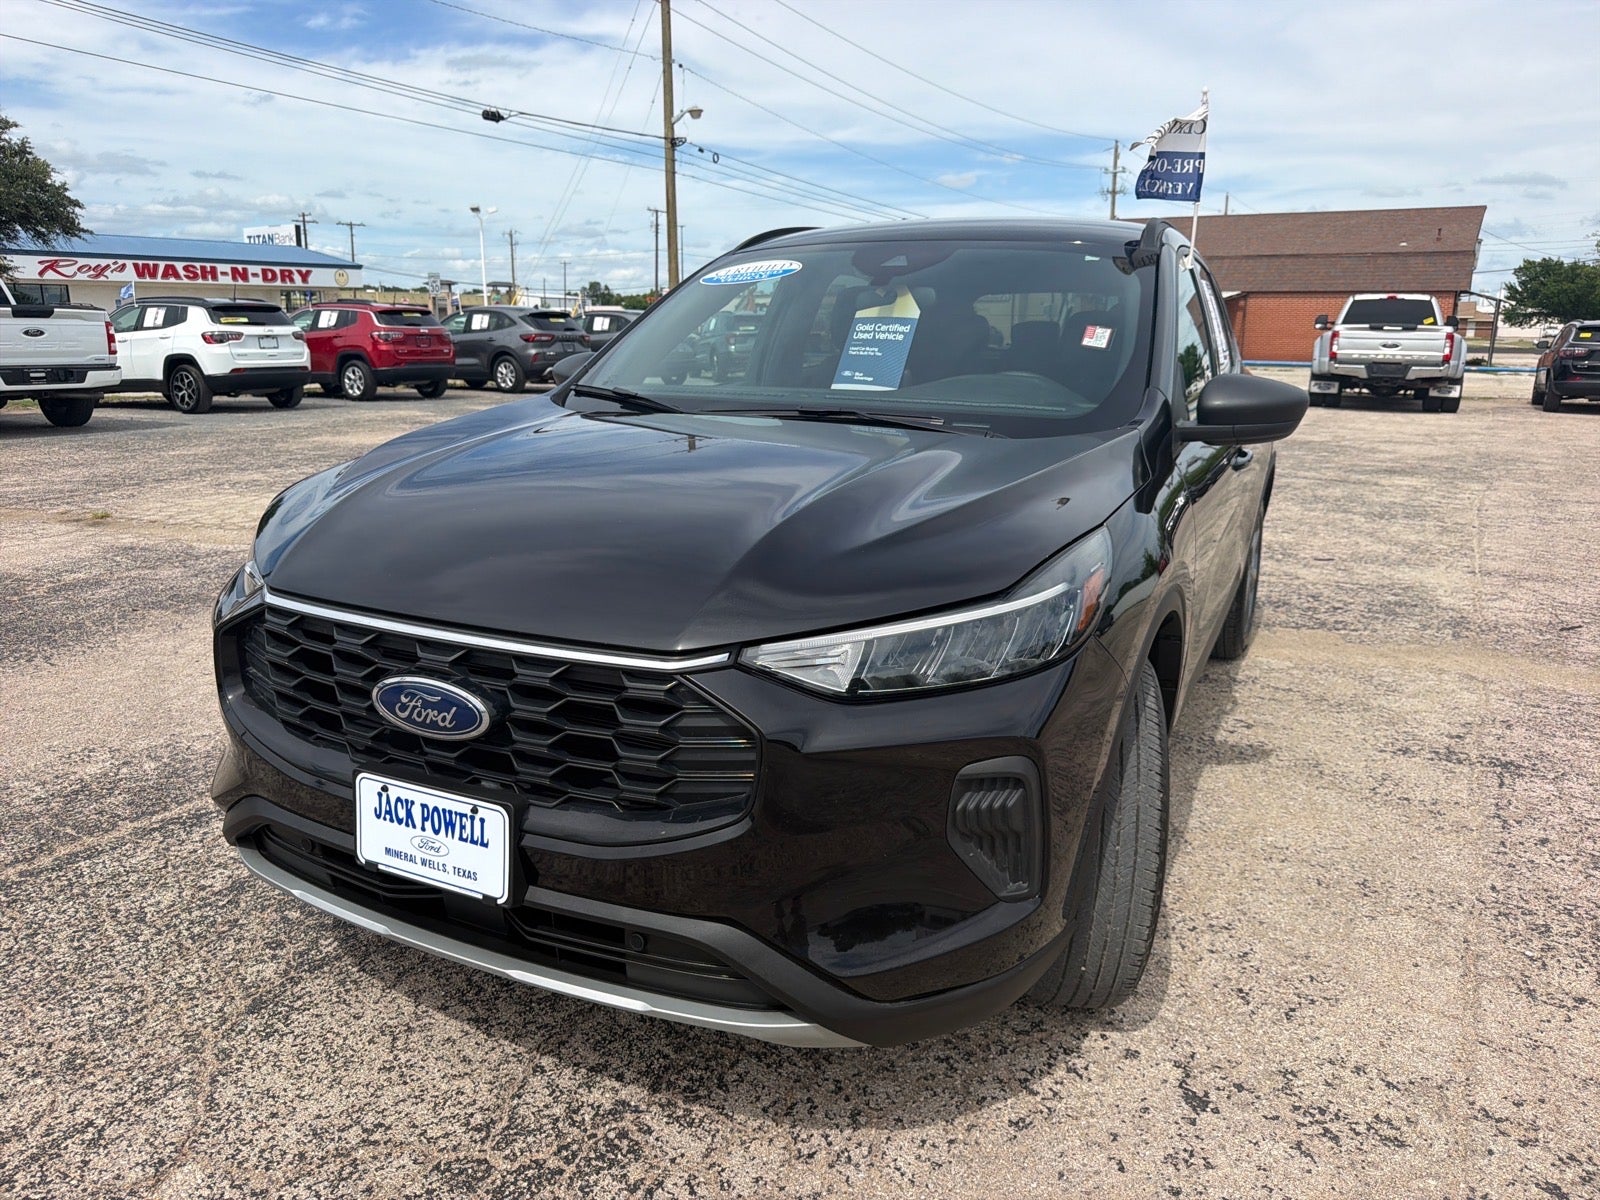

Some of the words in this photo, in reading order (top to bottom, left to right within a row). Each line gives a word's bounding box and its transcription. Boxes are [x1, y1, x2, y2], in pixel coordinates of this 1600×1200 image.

[37, 258, 127, 279] Roy's
[132, 262, 313, 284] WASH-N-DRY
[853, 331, 874, 339] Used
[875, 332, 904, 341] Vehicle
[855, 323, 875, 331] Gold
[875, 323, 911, 332] Certified
[395, 688, 457, 728] Ford
[374, 791, 417, 829] JACK
[420, 803, 489, 849] POWELL
[418, 838, 442, 853] Ford
[384, 847, 418, 865] MINERAL
[452, 866, 478, 882] TEXAS
